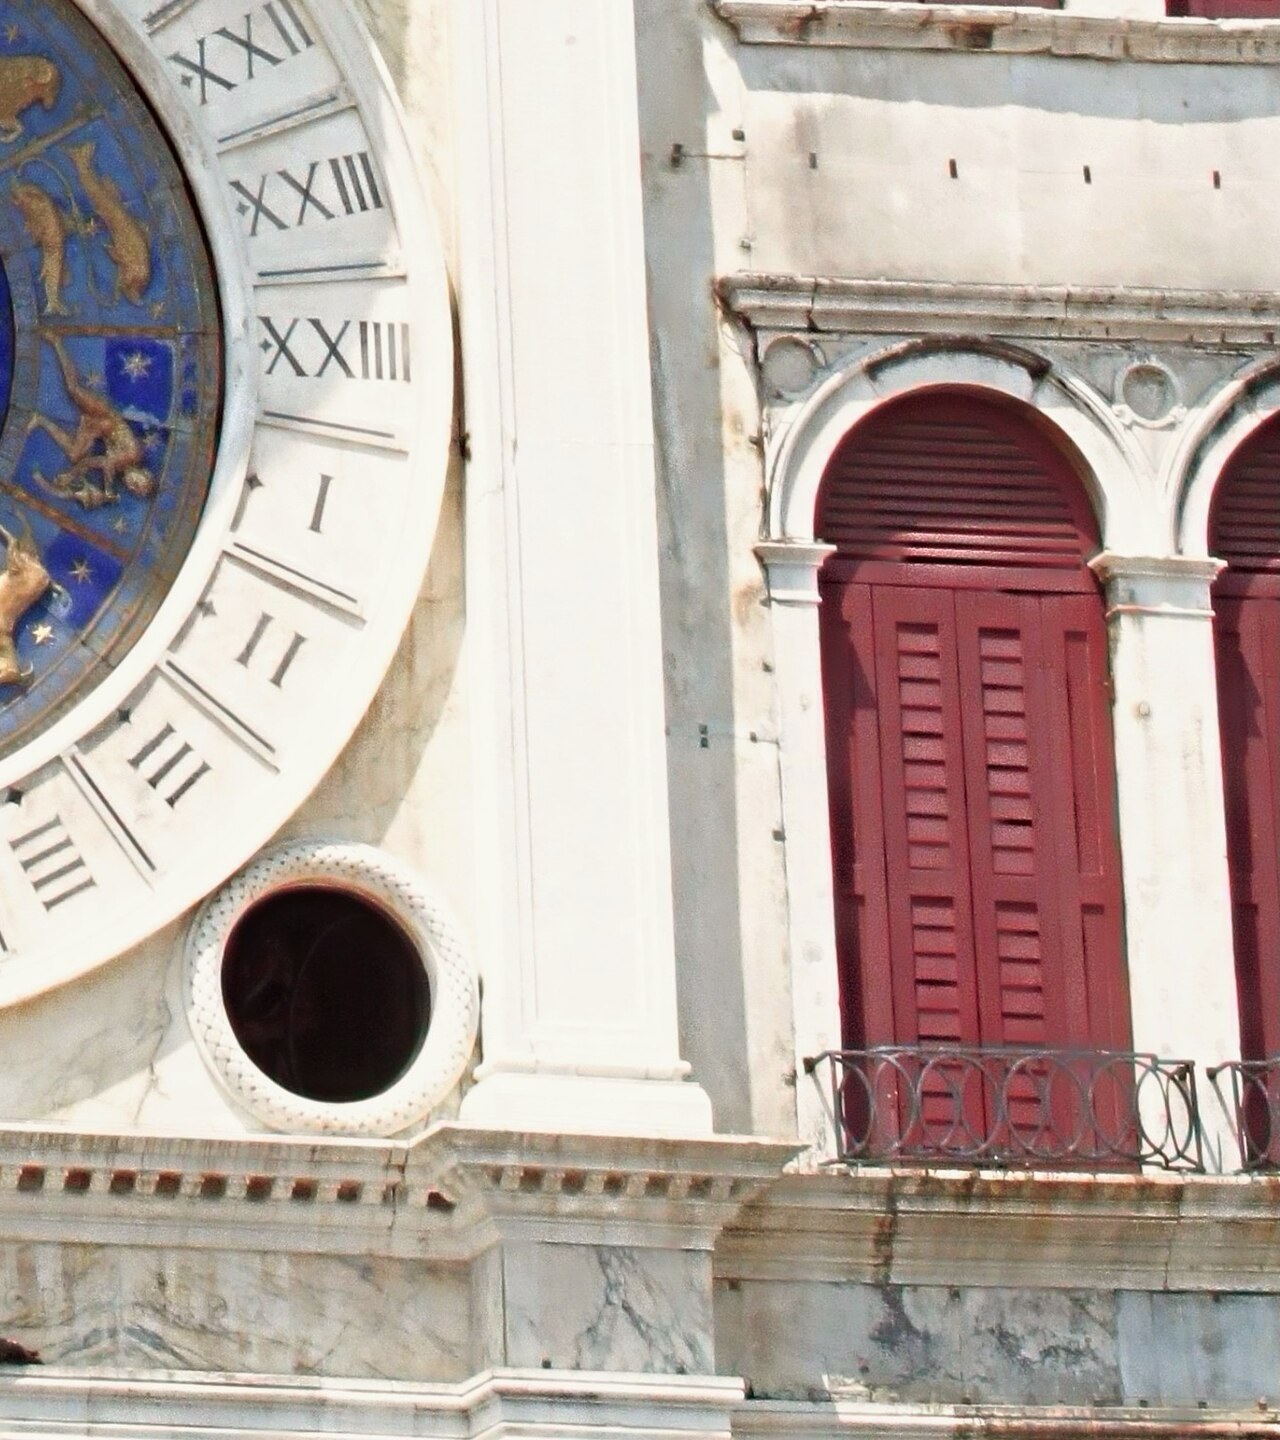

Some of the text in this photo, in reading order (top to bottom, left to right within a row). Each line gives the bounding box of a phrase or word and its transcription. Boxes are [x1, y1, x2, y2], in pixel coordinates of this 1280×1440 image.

[229, 152, 383, 236] XXIII
[258, 315, 411, 382] XXIIII
[308, 473, 334, 534] I
[234, 611, 308, 689] II
[127, 722, 213, 810] III
[9, 814, 97, 912] IIII
